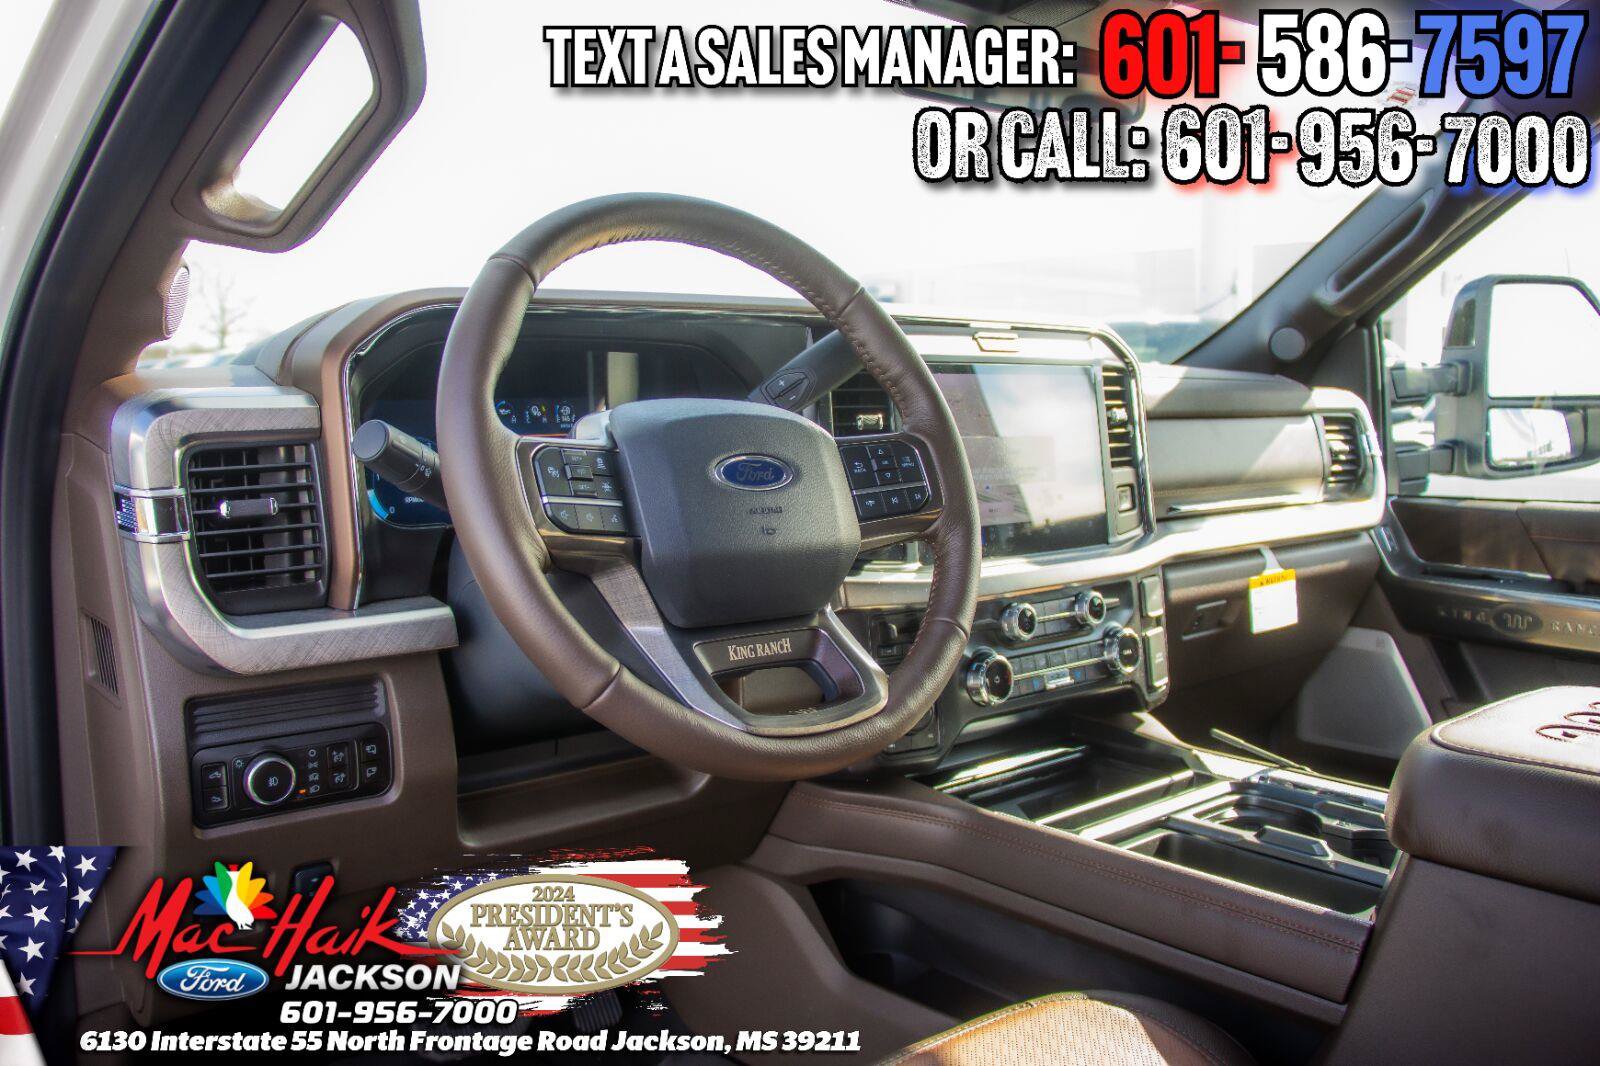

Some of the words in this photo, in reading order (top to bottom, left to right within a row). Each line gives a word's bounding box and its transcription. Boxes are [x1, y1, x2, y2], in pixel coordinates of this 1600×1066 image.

[737, 462, 775, 481] Ford
[1551, 620, 1600, 640] RANC
[728, 645, 755, 661] KING
[756, 637, 792, 657] RANCH
